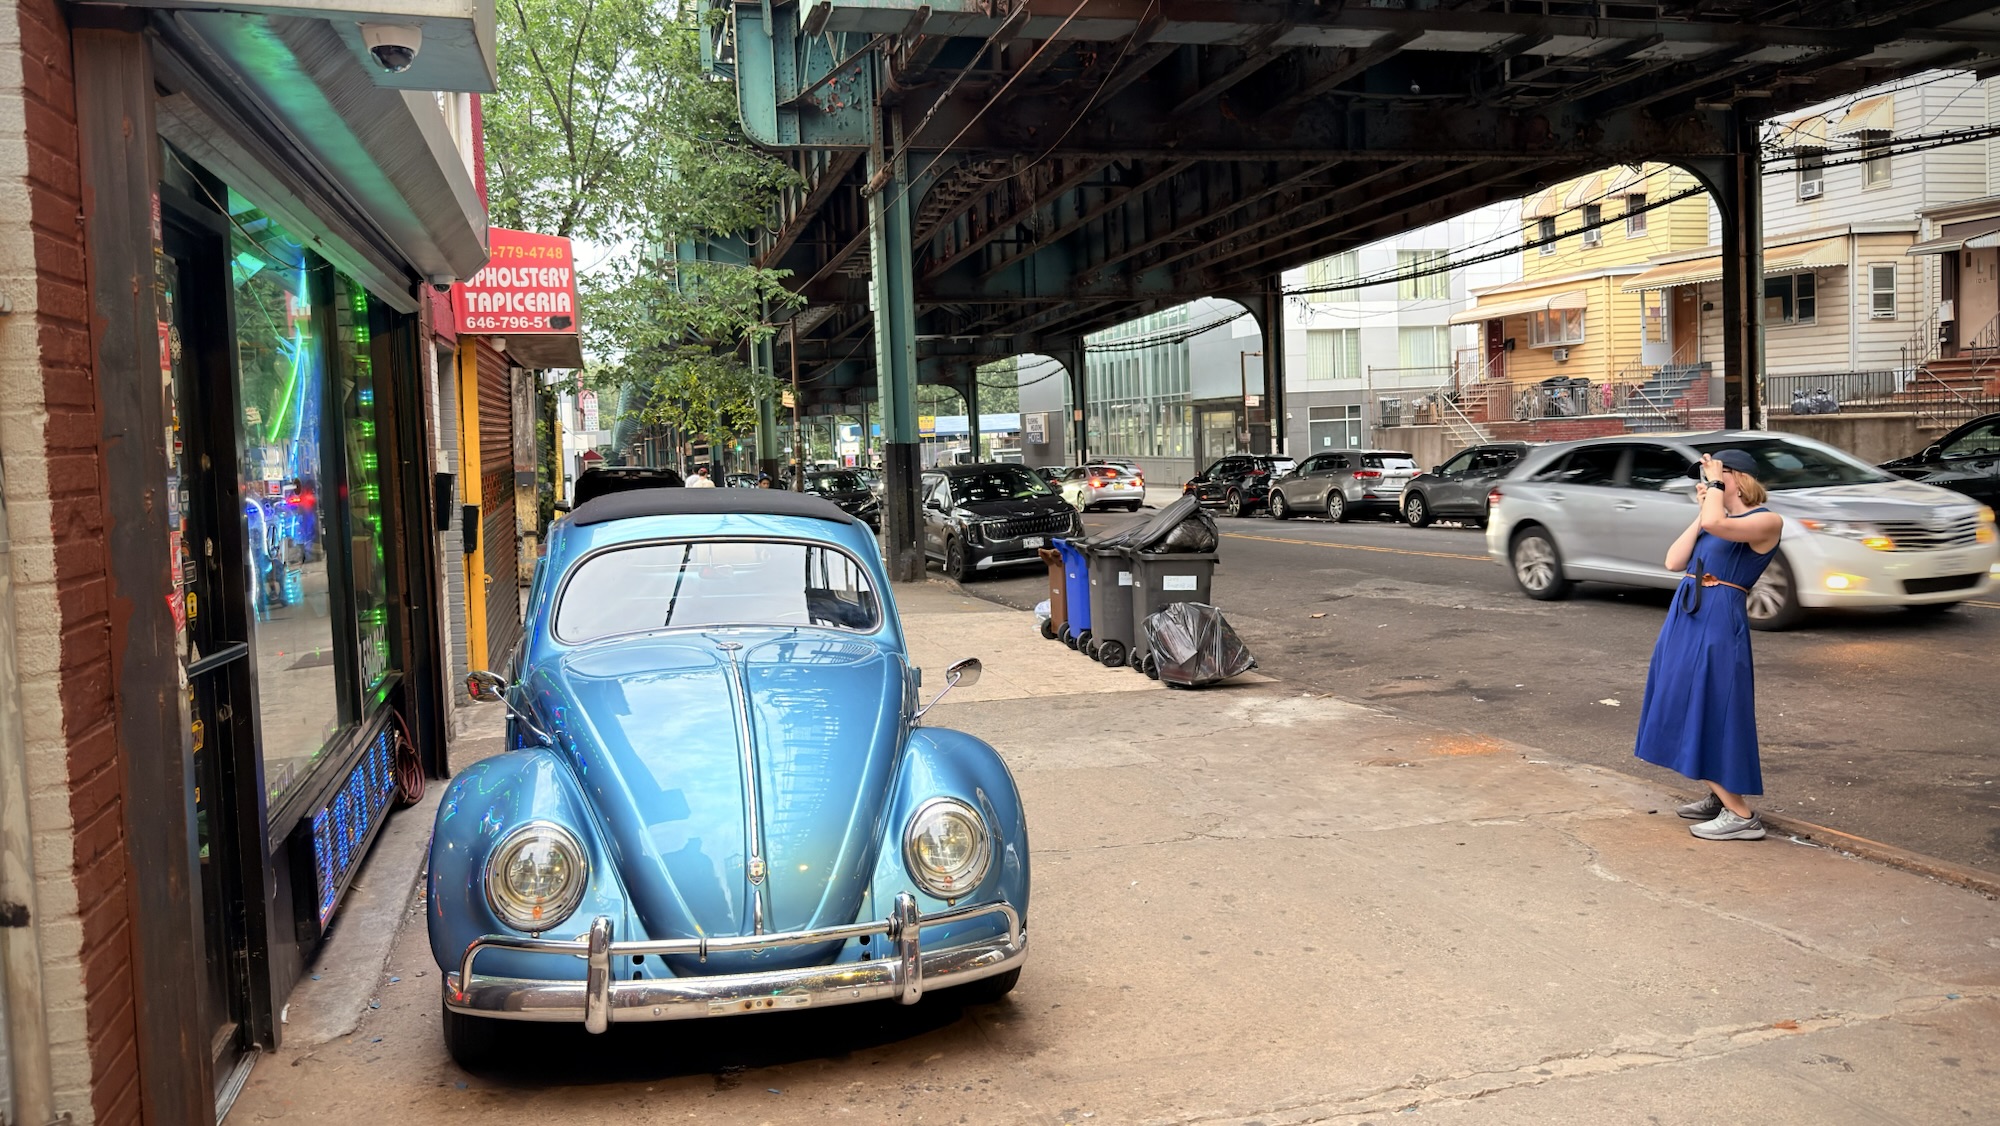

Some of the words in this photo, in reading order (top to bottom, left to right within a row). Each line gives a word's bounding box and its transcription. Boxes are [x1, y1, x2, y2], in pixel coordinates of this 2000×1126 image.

[490, 246, 563, 259] -779-4748
[465, 292, 571, 313] TAPICERIA
[466, 316, 571, 329] 646-796-51
[1027, 433, 1042, 443] HOTEL
